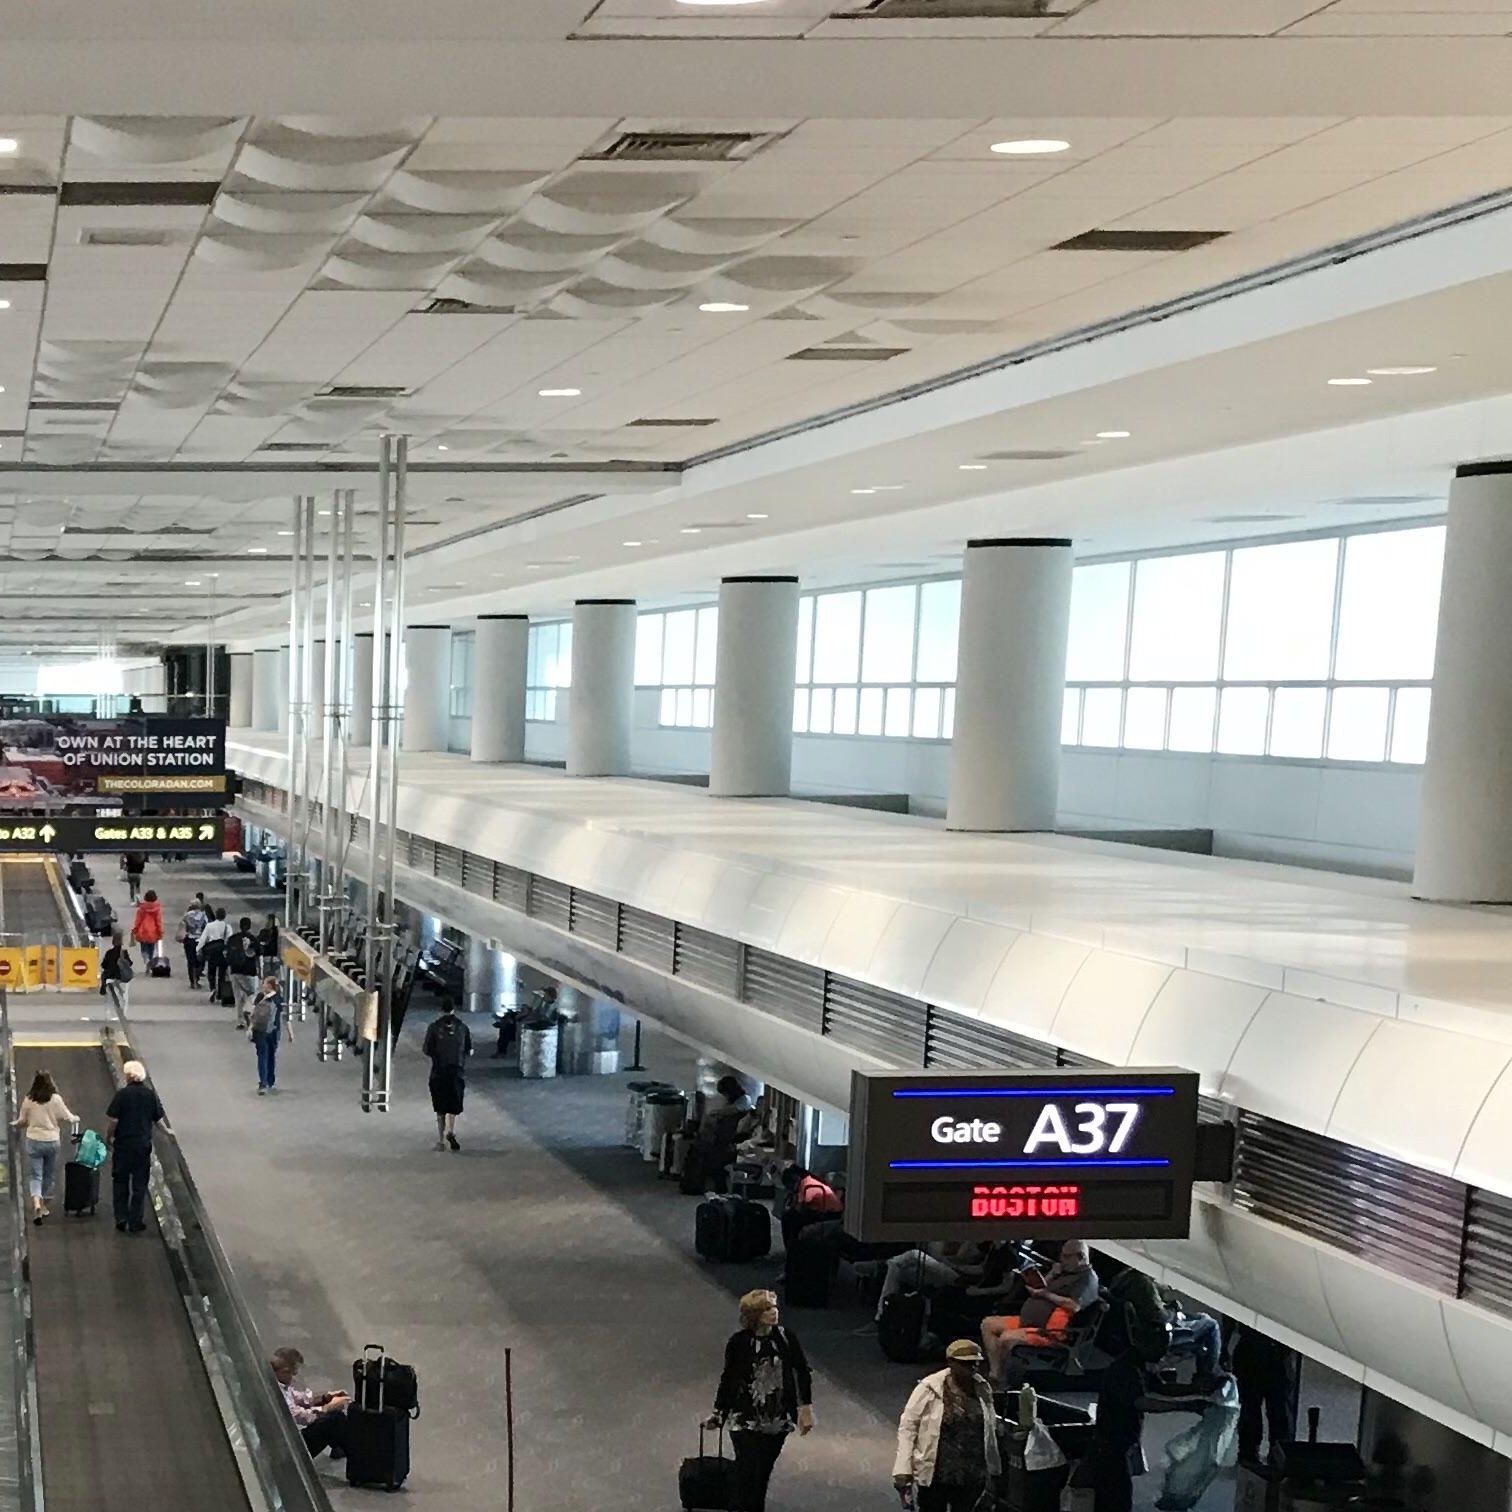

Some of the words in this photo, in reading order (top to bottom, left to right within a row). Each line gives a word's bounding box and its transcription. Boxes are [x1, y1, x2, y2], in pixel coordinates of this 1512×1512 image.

[58, 736, 99, 749] OWN
[103, 736, 123, 749] AT
[128, 736, 158, 749] THE
[163, 736, 217, 749] HEART
[64, 753, 86, 766] OF
[91, 753, 142, 766] UNION
[147, 753, 214, 766] STATION
[104, 780, 214, 789] THECOLORADAN.COM
[12, 827, 36, 839] A32
[94, 827, 127, 839] Gates
[130, 827, 154, 839] A33
[156, 827, 167, 839] &
[169, 827, 193, 839] A35
[931, 1116, 1001, 1143] Gate
[1023, 1103, 1140, 1154] A37
[971, 1186, 1080, 1217] BOSTON
